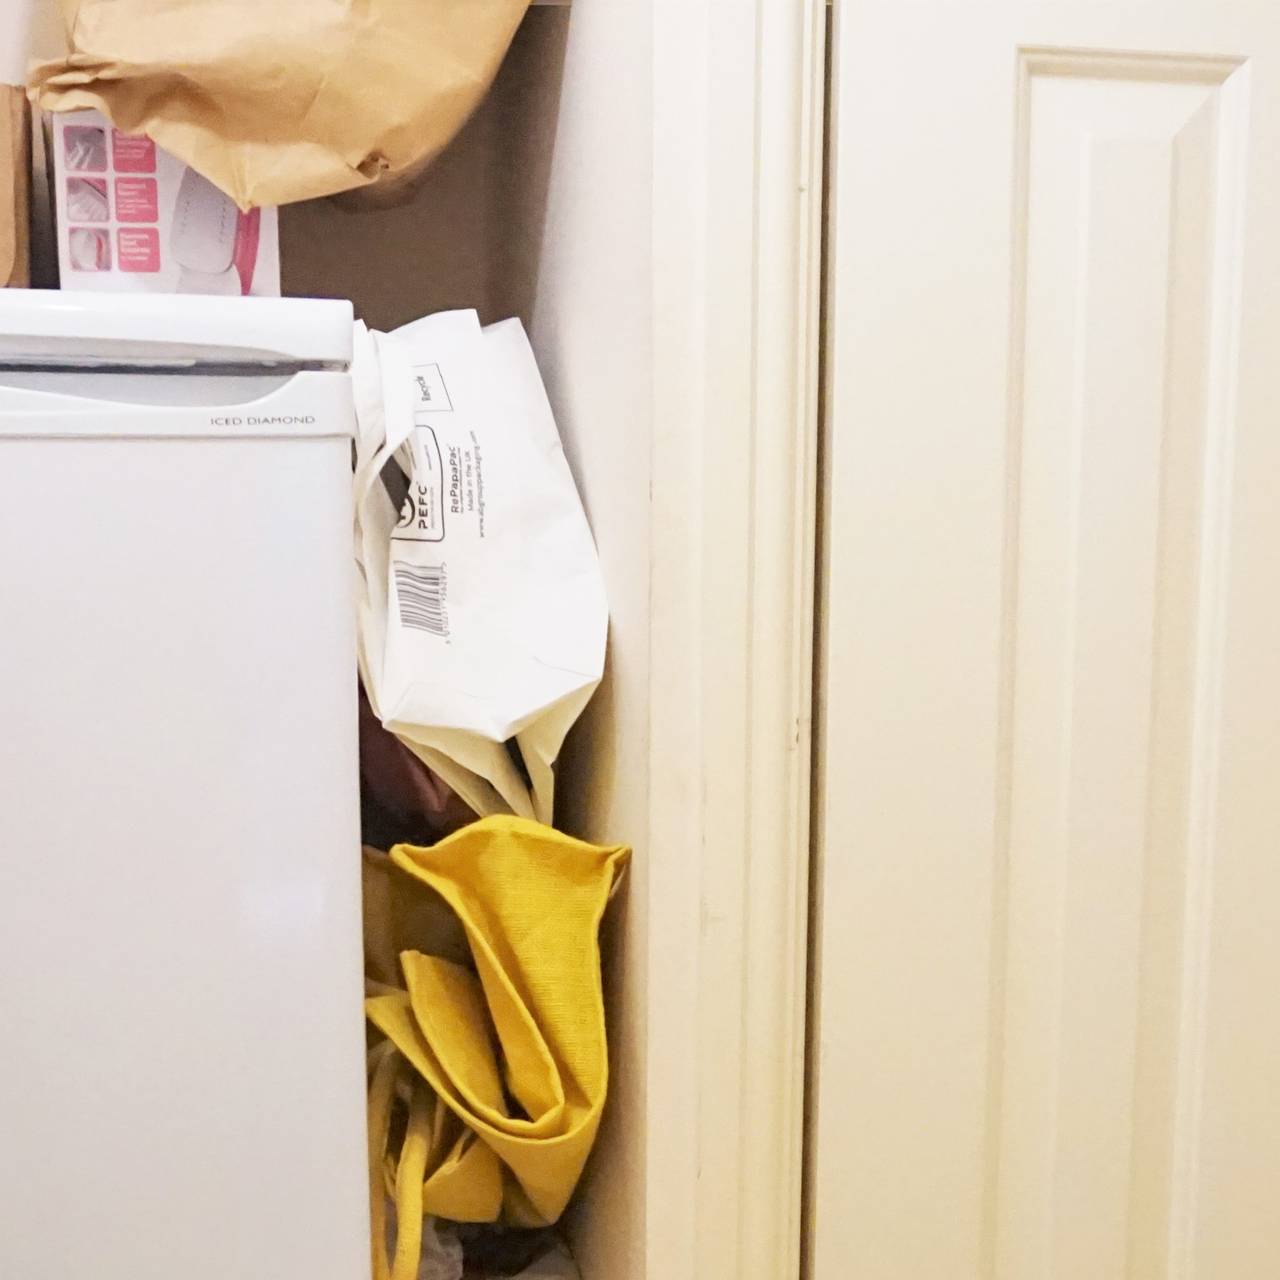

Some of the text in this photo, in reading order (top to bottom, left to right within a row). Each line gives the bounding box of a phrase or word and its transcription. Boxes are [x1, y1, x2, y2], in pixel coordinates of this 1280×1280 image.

[416, 375, 431, 401] Recycle
[210, 415, 316, 426] ICED DIAMOND
[448, 445, 460, 514] RePapaPac
[465, 464, 473, 478] the
[418, 484, 428, 530] PEFC
[466, 489, 474, 512] Made
